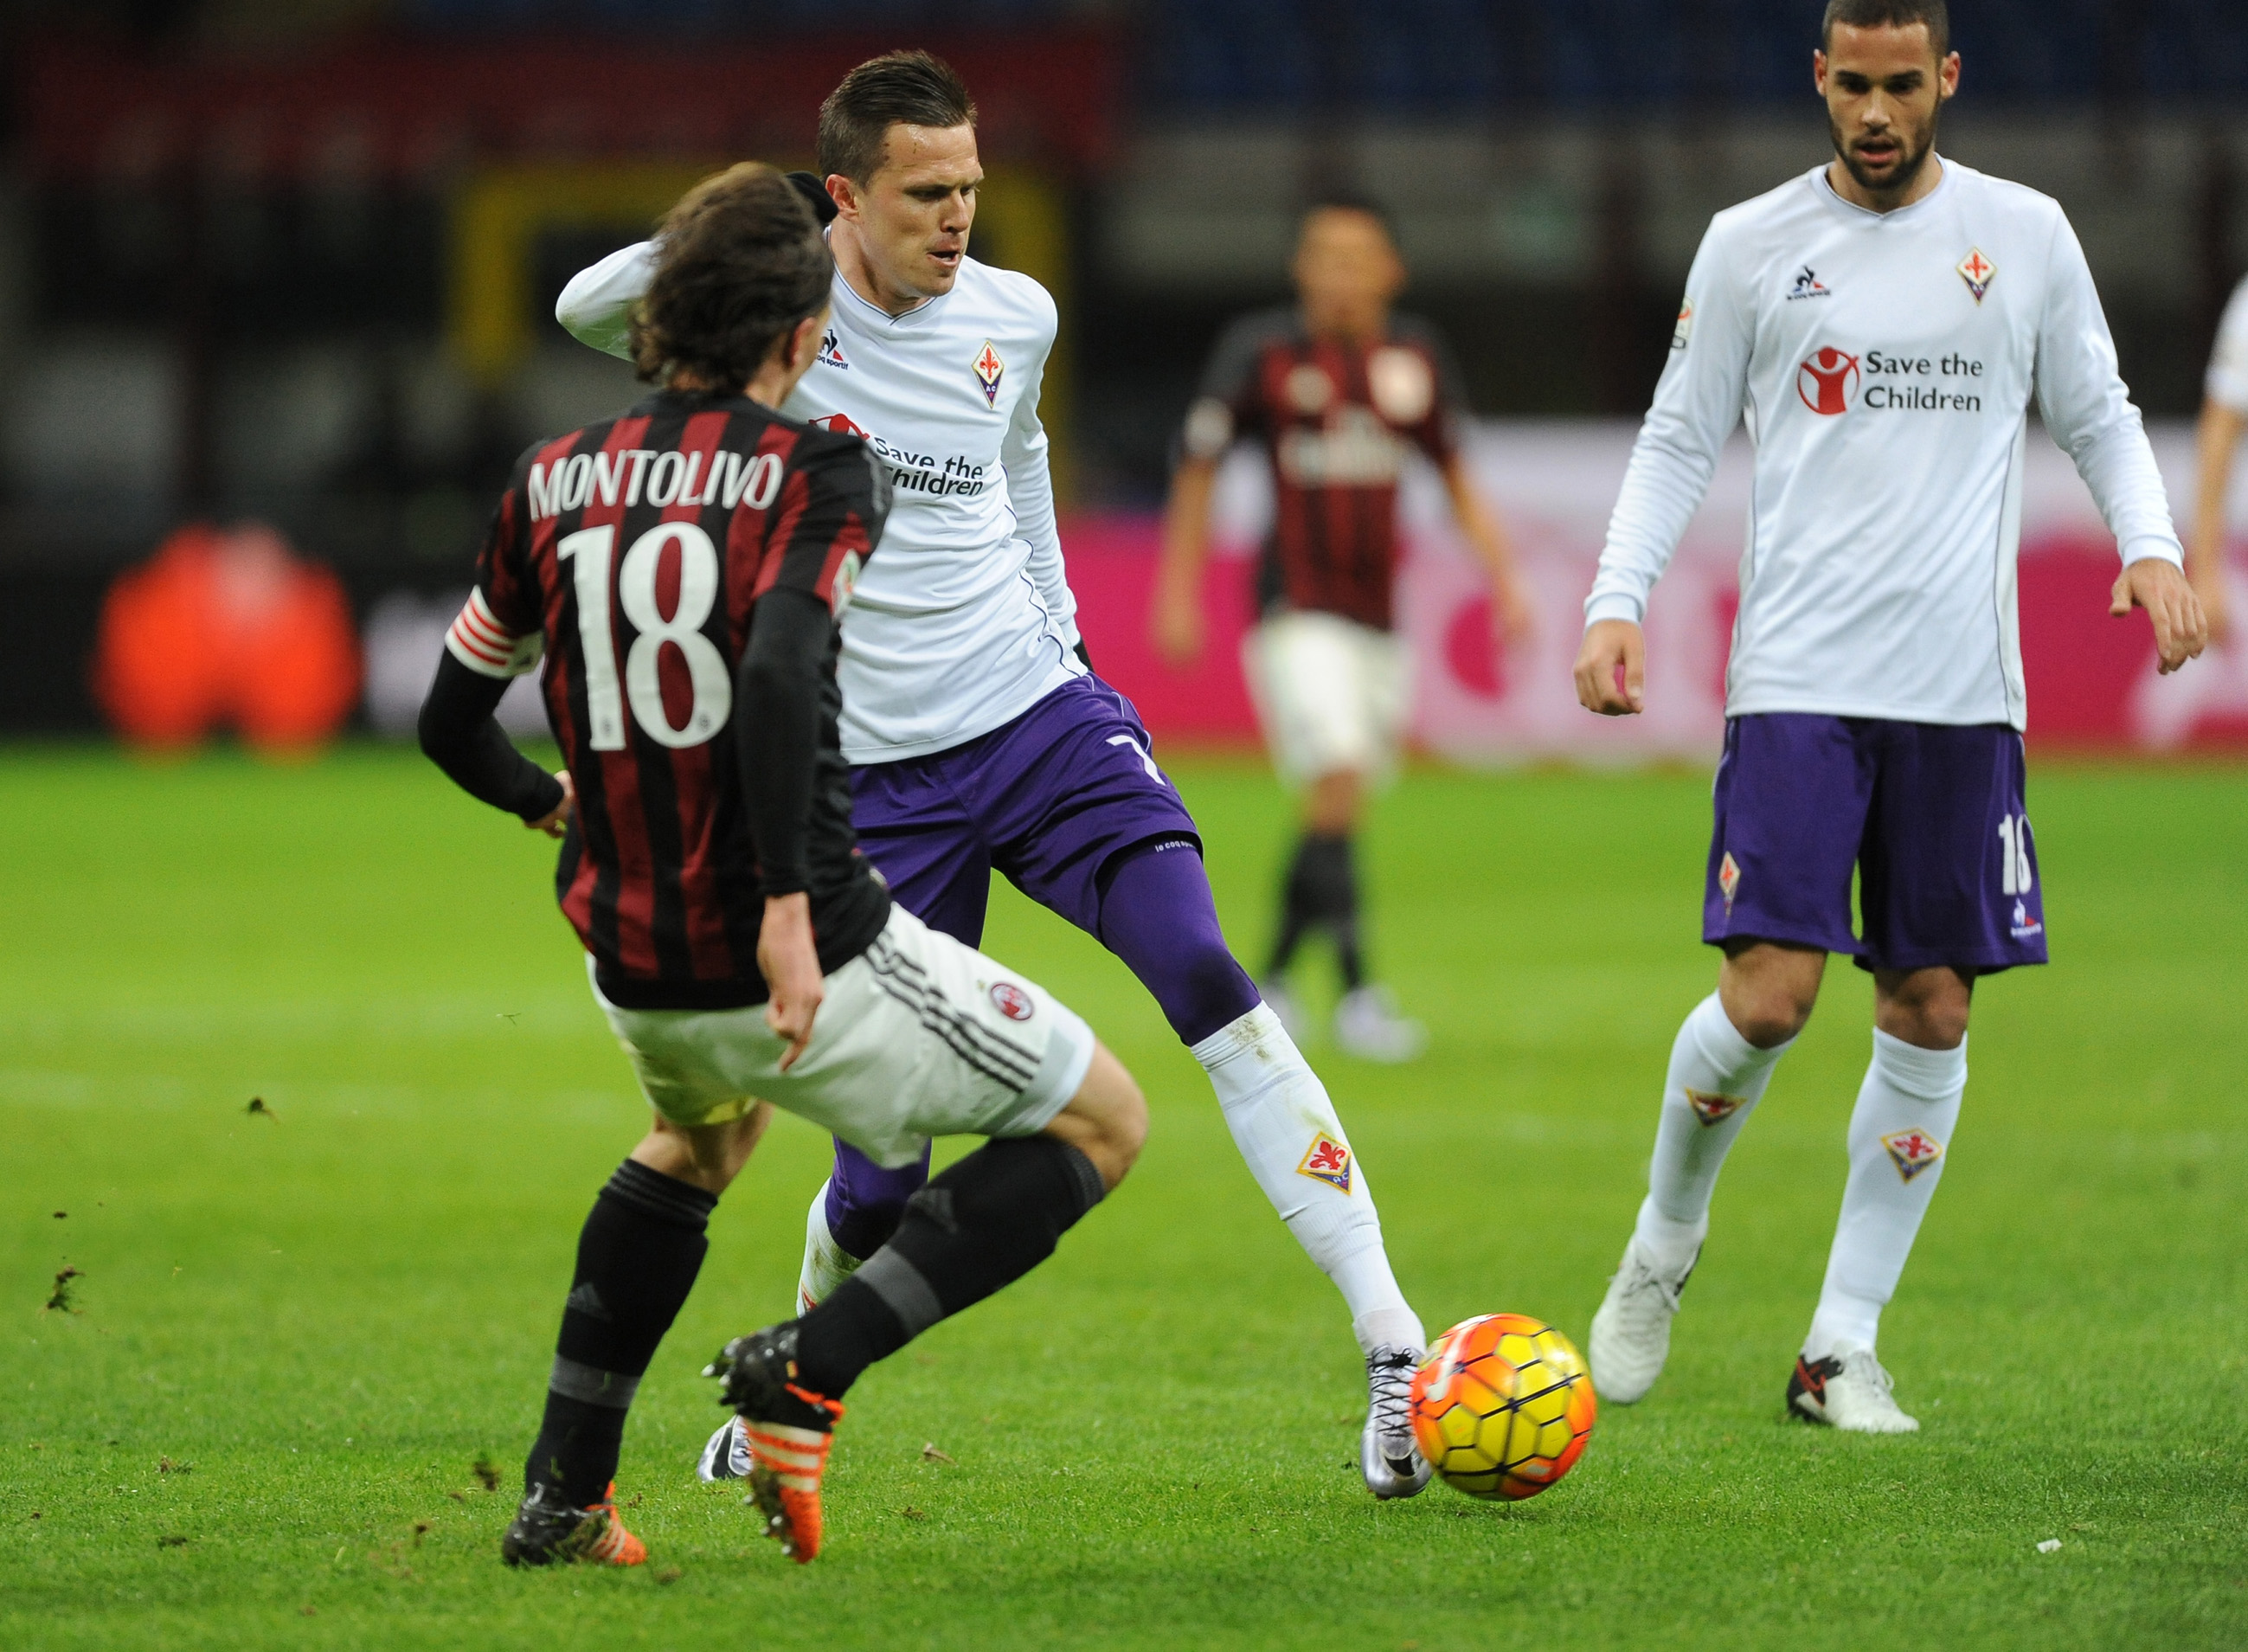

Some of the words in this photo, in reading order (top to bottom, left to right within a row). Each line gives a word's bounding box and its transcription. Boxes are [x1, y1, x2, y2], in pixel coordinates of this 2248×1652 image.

[1866, 350, 1931, 375] Save
[1941, 352, 1982, 376] the
[1864, 386, 1981, 411] Children
[874, 436, 935, 467] Save
[945, 455, 983, 479] the
[528, 449, 784, 522] MONTOLIVO
[556, 521, 733, 751] 18
